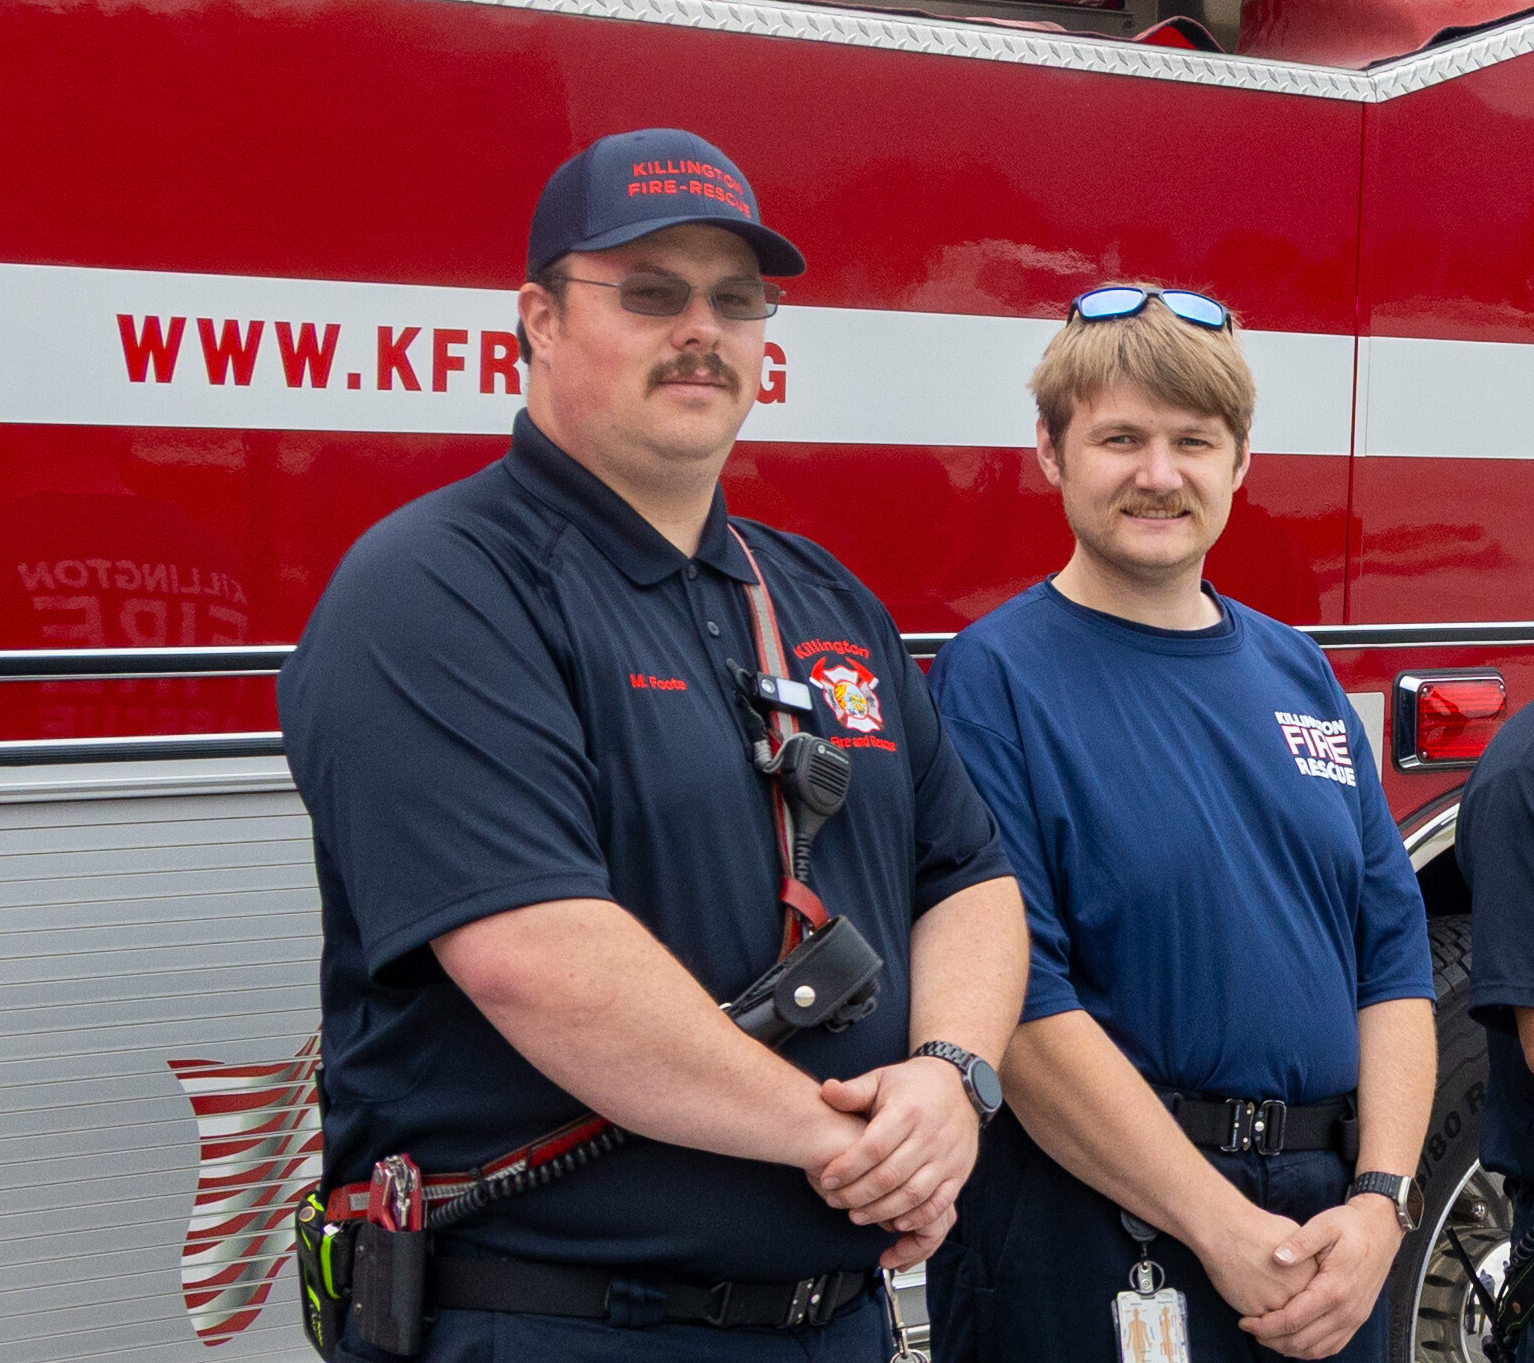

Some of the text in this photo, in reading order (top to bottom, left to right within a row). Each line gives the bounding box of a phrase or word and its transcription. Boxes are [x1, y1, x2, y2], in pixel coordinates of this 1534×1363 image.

[633, 160, 744, 195] KILLINGTON
[628, 179, 751, 219] FIRE-RESCUE
[794, 639, 869, 659] Killington
[1281, 725, 1352, 766] FIRE
[1294, 757, 1356, 787] RESCUE
